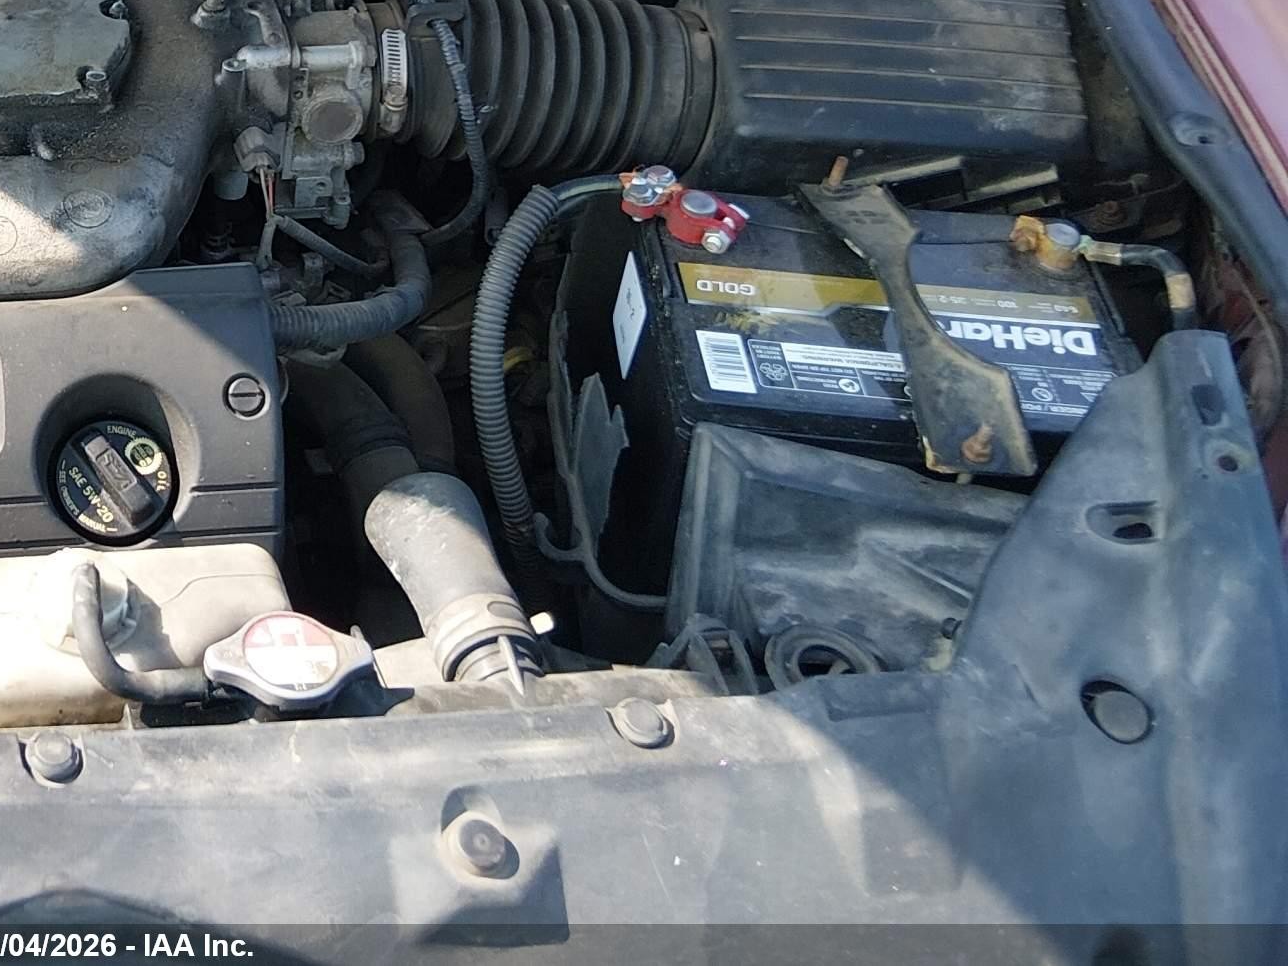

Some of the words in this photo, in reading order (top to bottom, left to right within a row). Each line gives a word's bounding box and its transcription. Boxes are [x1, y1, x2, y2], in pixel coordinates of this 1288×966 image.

[695, 278, 757, 297] GOLD
[106, 424, 137, 439] ENGINE
[155, 470, 170, 492] OIL
[68, 466, 88, 488] SAE
[82, 486, 114, 523] 5W-20
